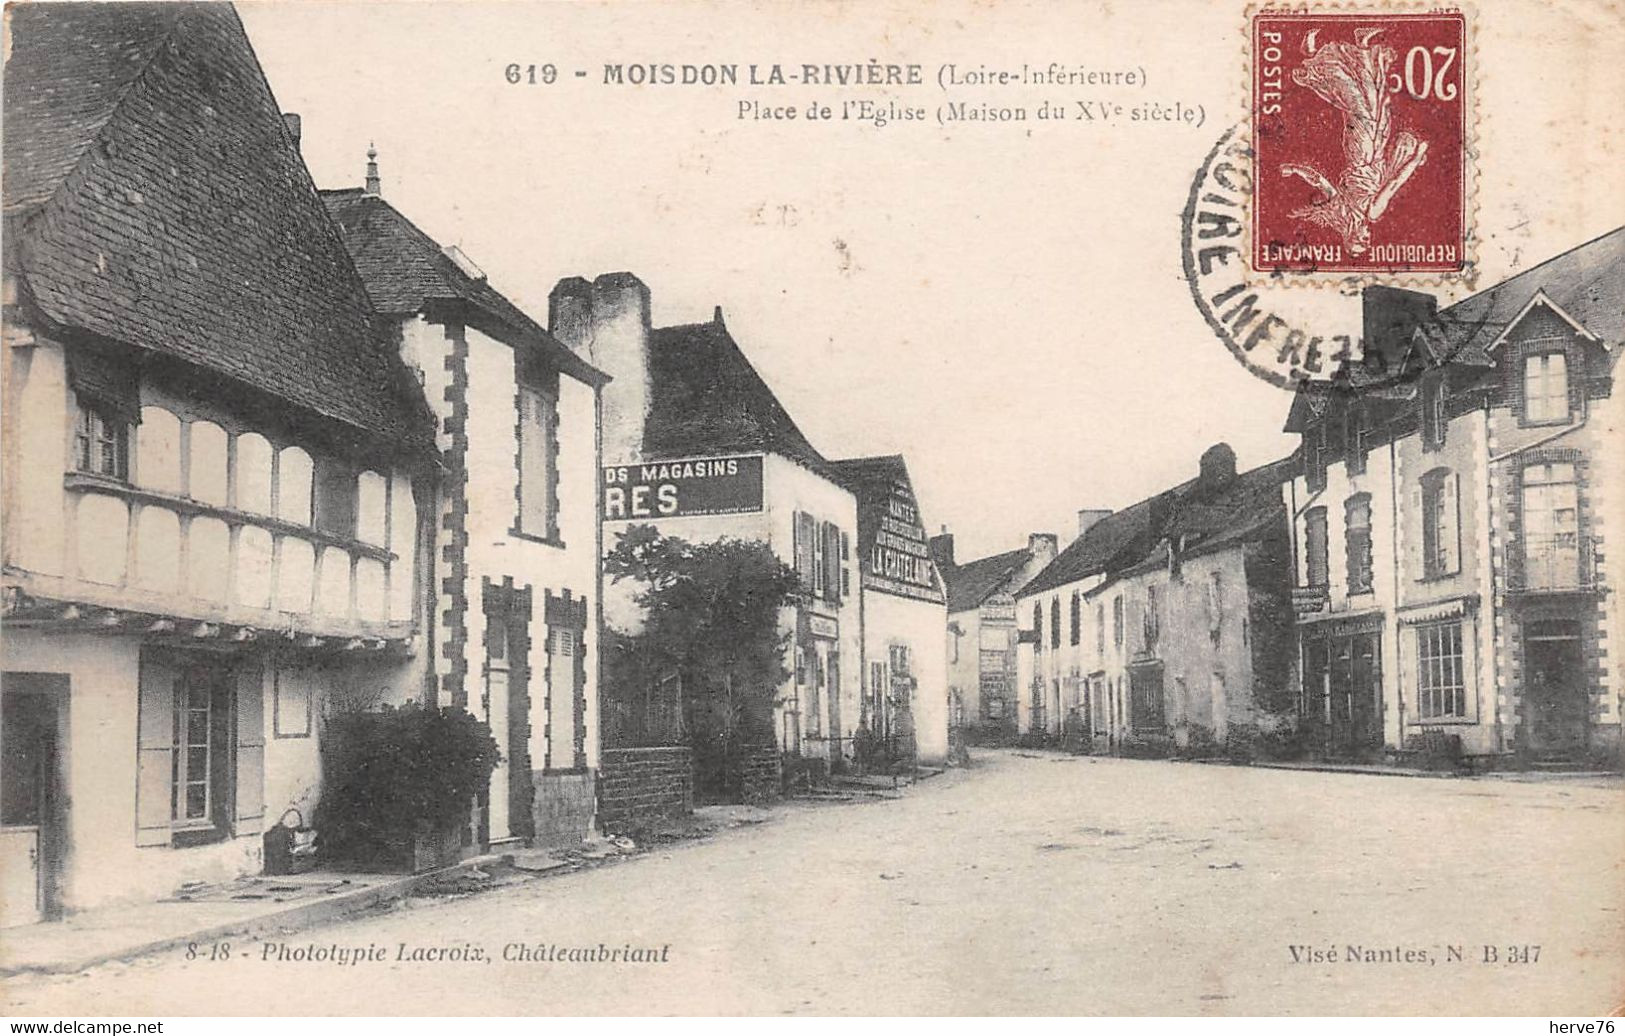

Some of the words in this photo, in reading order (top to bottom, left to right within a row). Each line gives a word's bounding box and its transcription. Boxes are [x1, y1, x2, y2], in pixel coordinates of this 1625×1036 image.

[1263, 32, 1281, 115] POSTES
[1368, 244, 1456, 262] REPUBLIQUE
[641, 460, 738, 481] MAGASINS
[605, 484, 678, 516] RES
